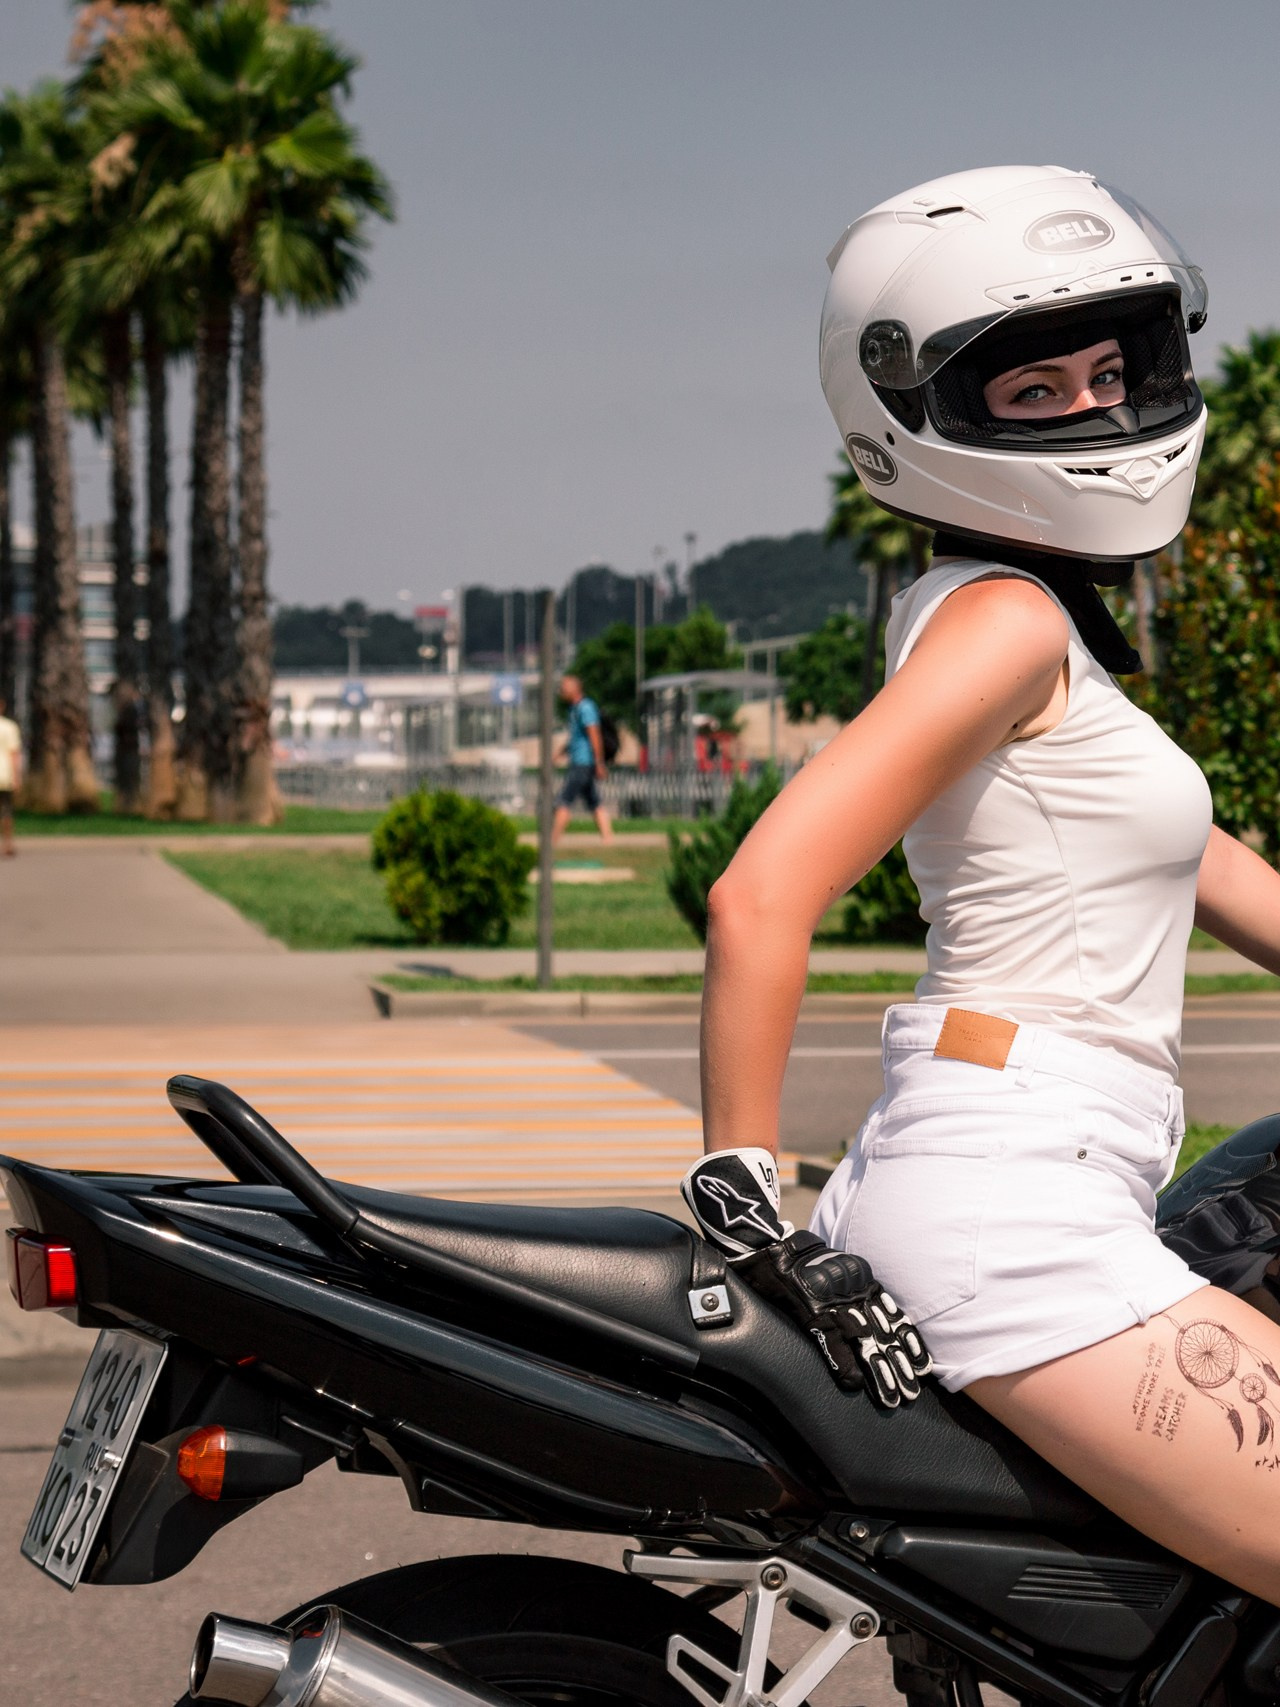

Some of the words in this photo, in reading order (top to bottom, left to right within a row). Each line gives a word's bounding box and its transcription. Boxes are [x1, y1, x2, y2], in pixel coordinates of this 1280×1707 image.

[1037, 218, 1105, 247] BELL
[853, 444, 890, 474] BELL
[82, 1350, 146, 1440] 1240
[1152, 1386, 1175, 1438] DREAMS
[1165, 1391, 1188, 1442] CATCHER
[29, 1462, 74, 1547] KO
[54, 1482, 104, 1566] 23
